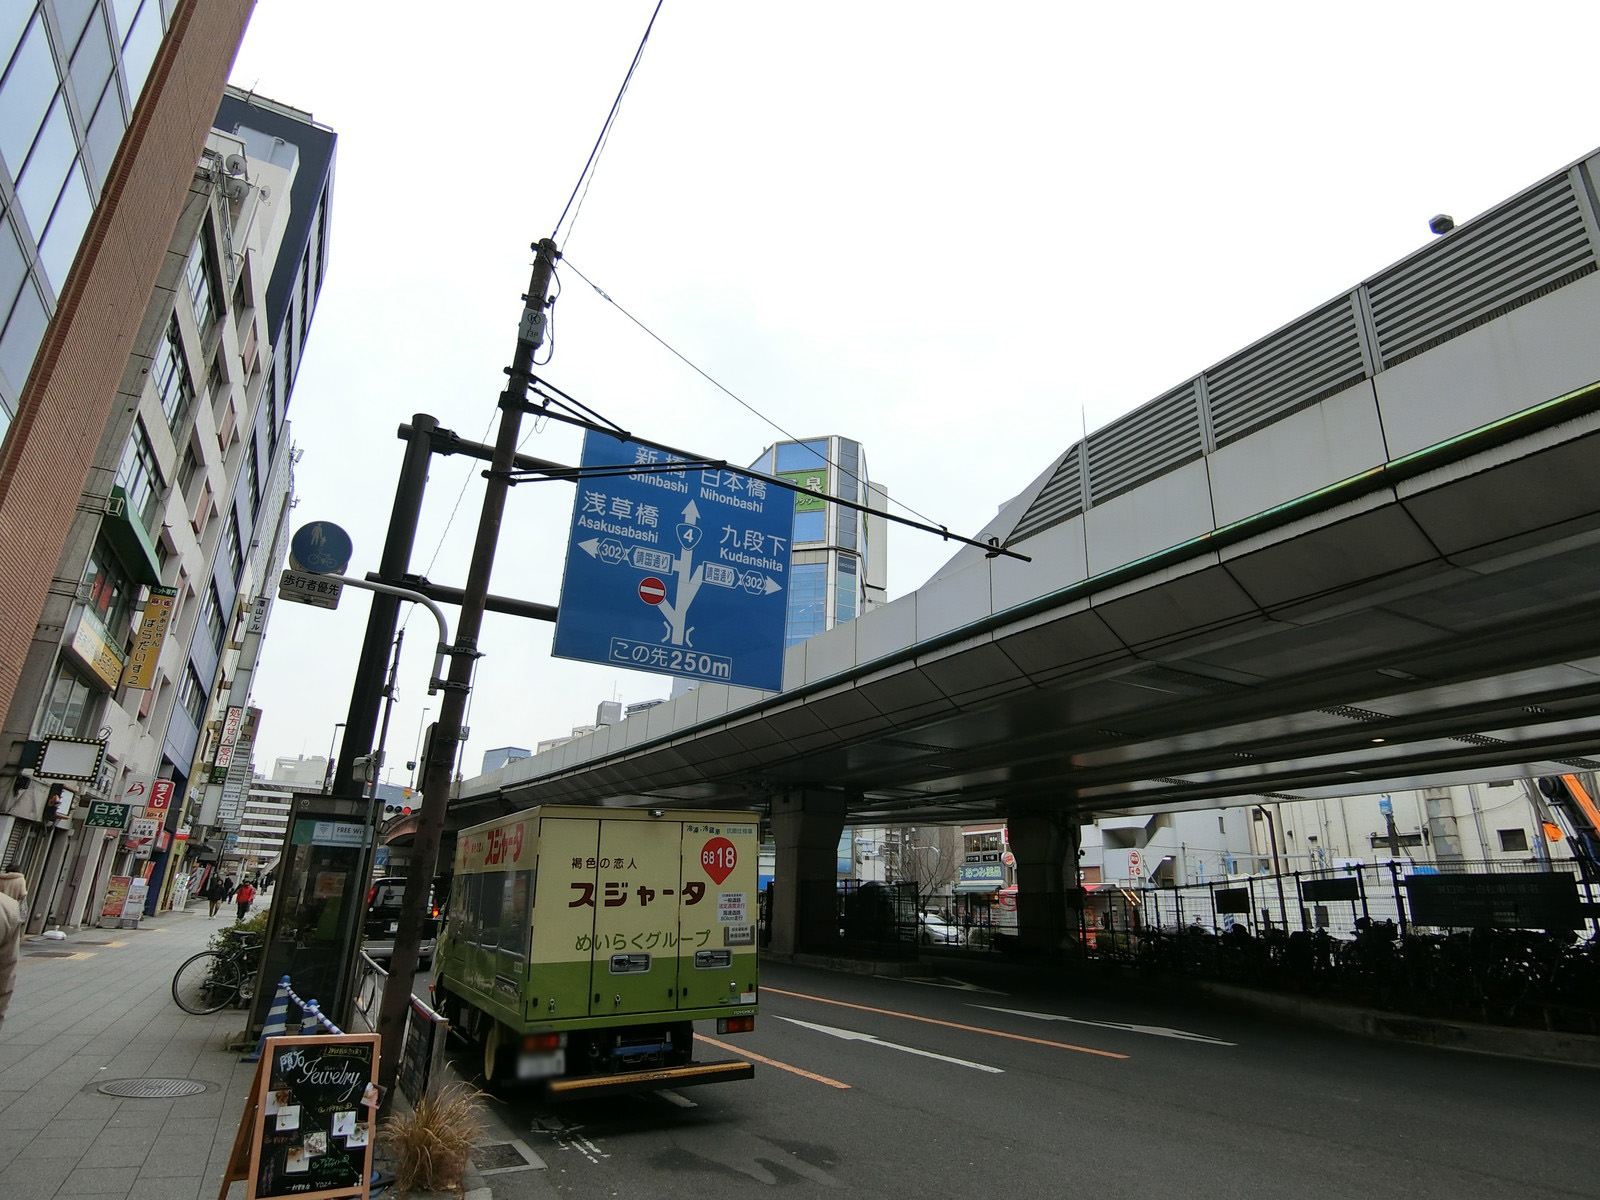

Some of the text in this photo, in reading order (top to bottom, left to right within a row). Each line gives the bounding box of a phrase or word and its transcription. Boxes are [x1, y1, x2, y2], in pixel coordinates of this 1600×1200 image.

[582, 490, 660, 528] 浅草橋
[700, 487, 764, 514] Nihonbashi
[577, 514, 660, 544] Asakusabashi
[684, 528, 694, 543] 4
[720, 524, 787, 557] 九段下
[601, 544, 622, 559] 302
[720, 548, 784, 572] Kudanshita
[284, 574, 340, 596] 歩行者優先
[745, 576, 763, 590] 302
[614, 642, 730, 678] この先250m
[224, 708, 240, 744] 処方せん
[218, 747, 232, 766] 受付
[154, 784, 169, 808] 宝くじ
[94, 803, 124, 816] 白衣
[485, 822, 524, 865] スジャータ
[572, 857, 638, 870] 褐色の恋人
[703, 847, 734, 868] 68 18
[568, 882, 706, 908] スジャータ
[574, 930, 710, 952] めいらくグループ
[296, 1056, 362, 1102] Jewelry
